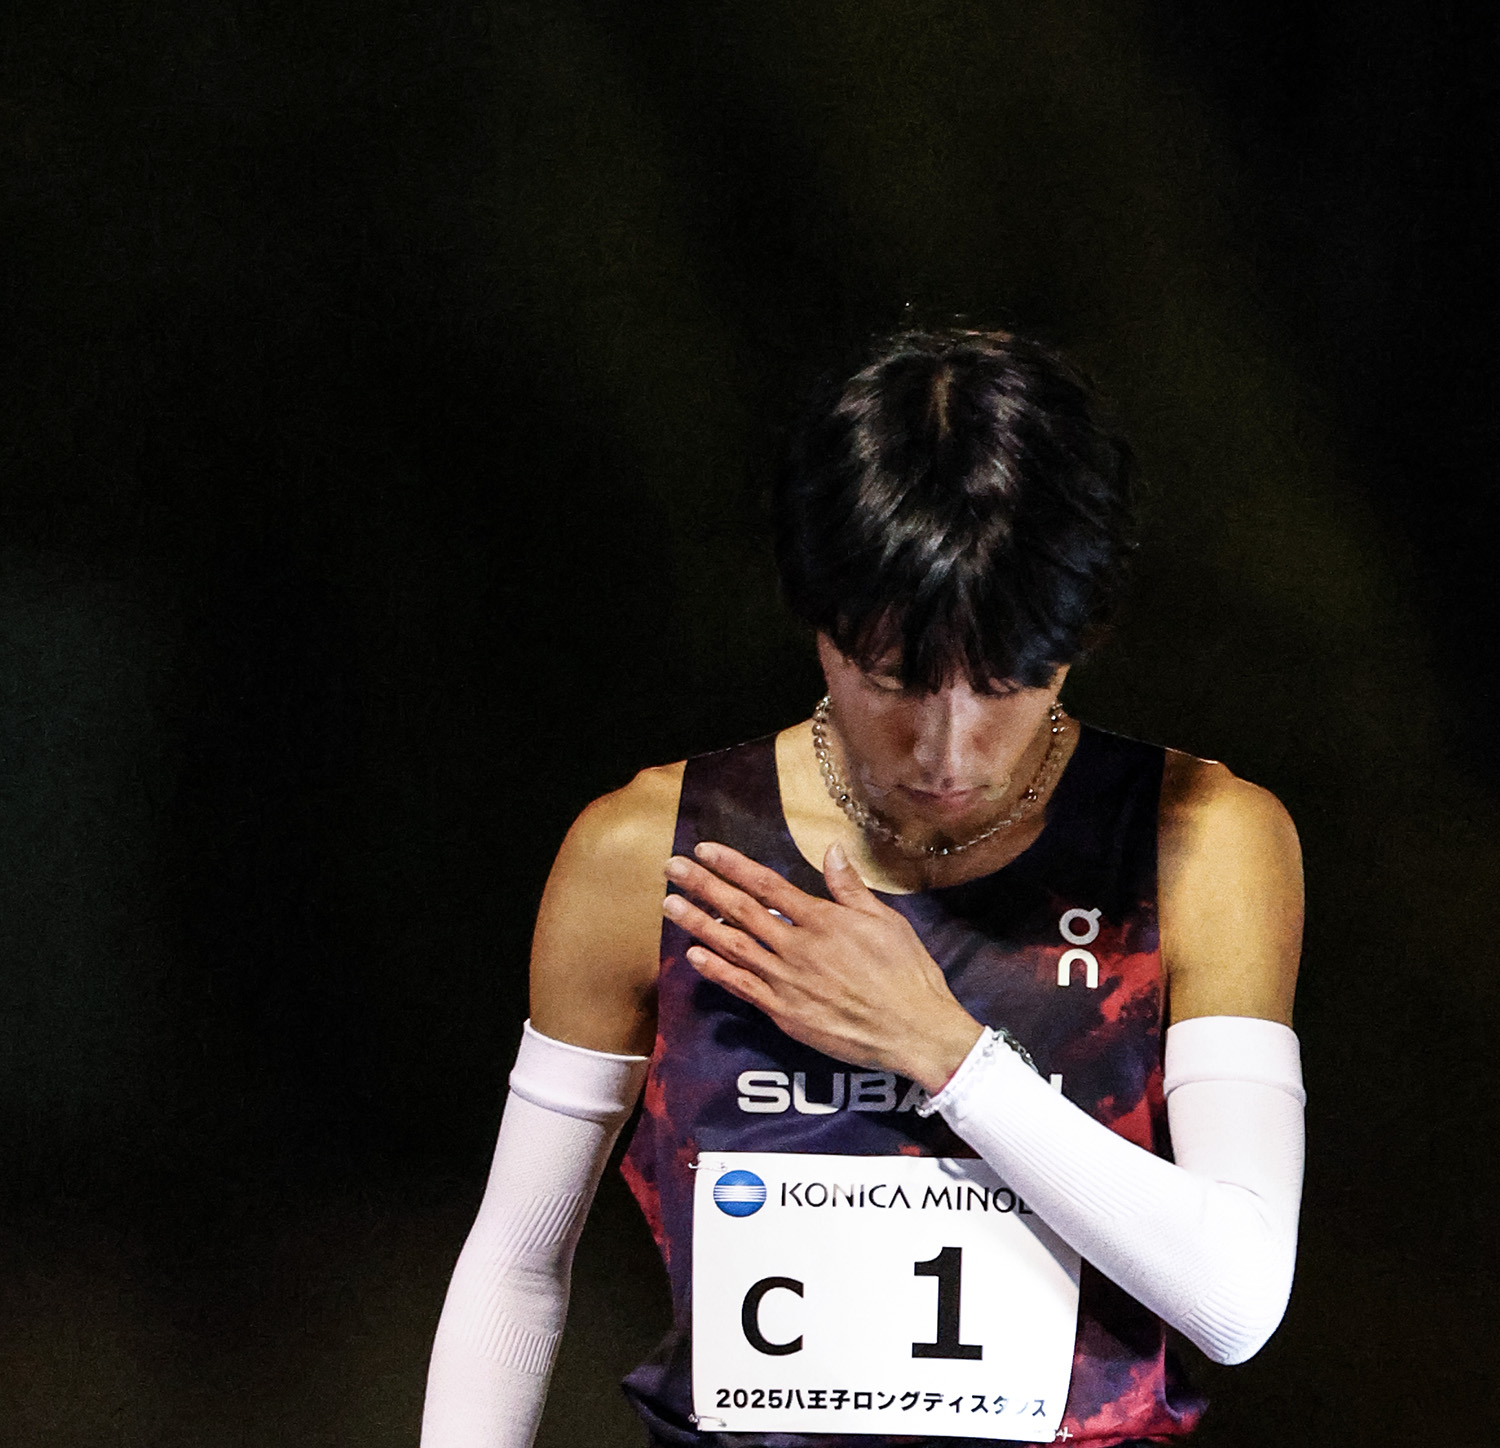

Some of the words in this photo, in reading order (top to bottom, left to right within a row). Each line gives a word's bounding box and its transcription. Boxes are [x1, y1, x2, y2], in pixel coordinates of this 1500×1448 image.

[781, 1182, 911, 1209] KONICA
[922, 1185, 1034, 1215] MINOL
[741, 1276, 804, 1356] C
[912, 1246, 983, 1361] 1
